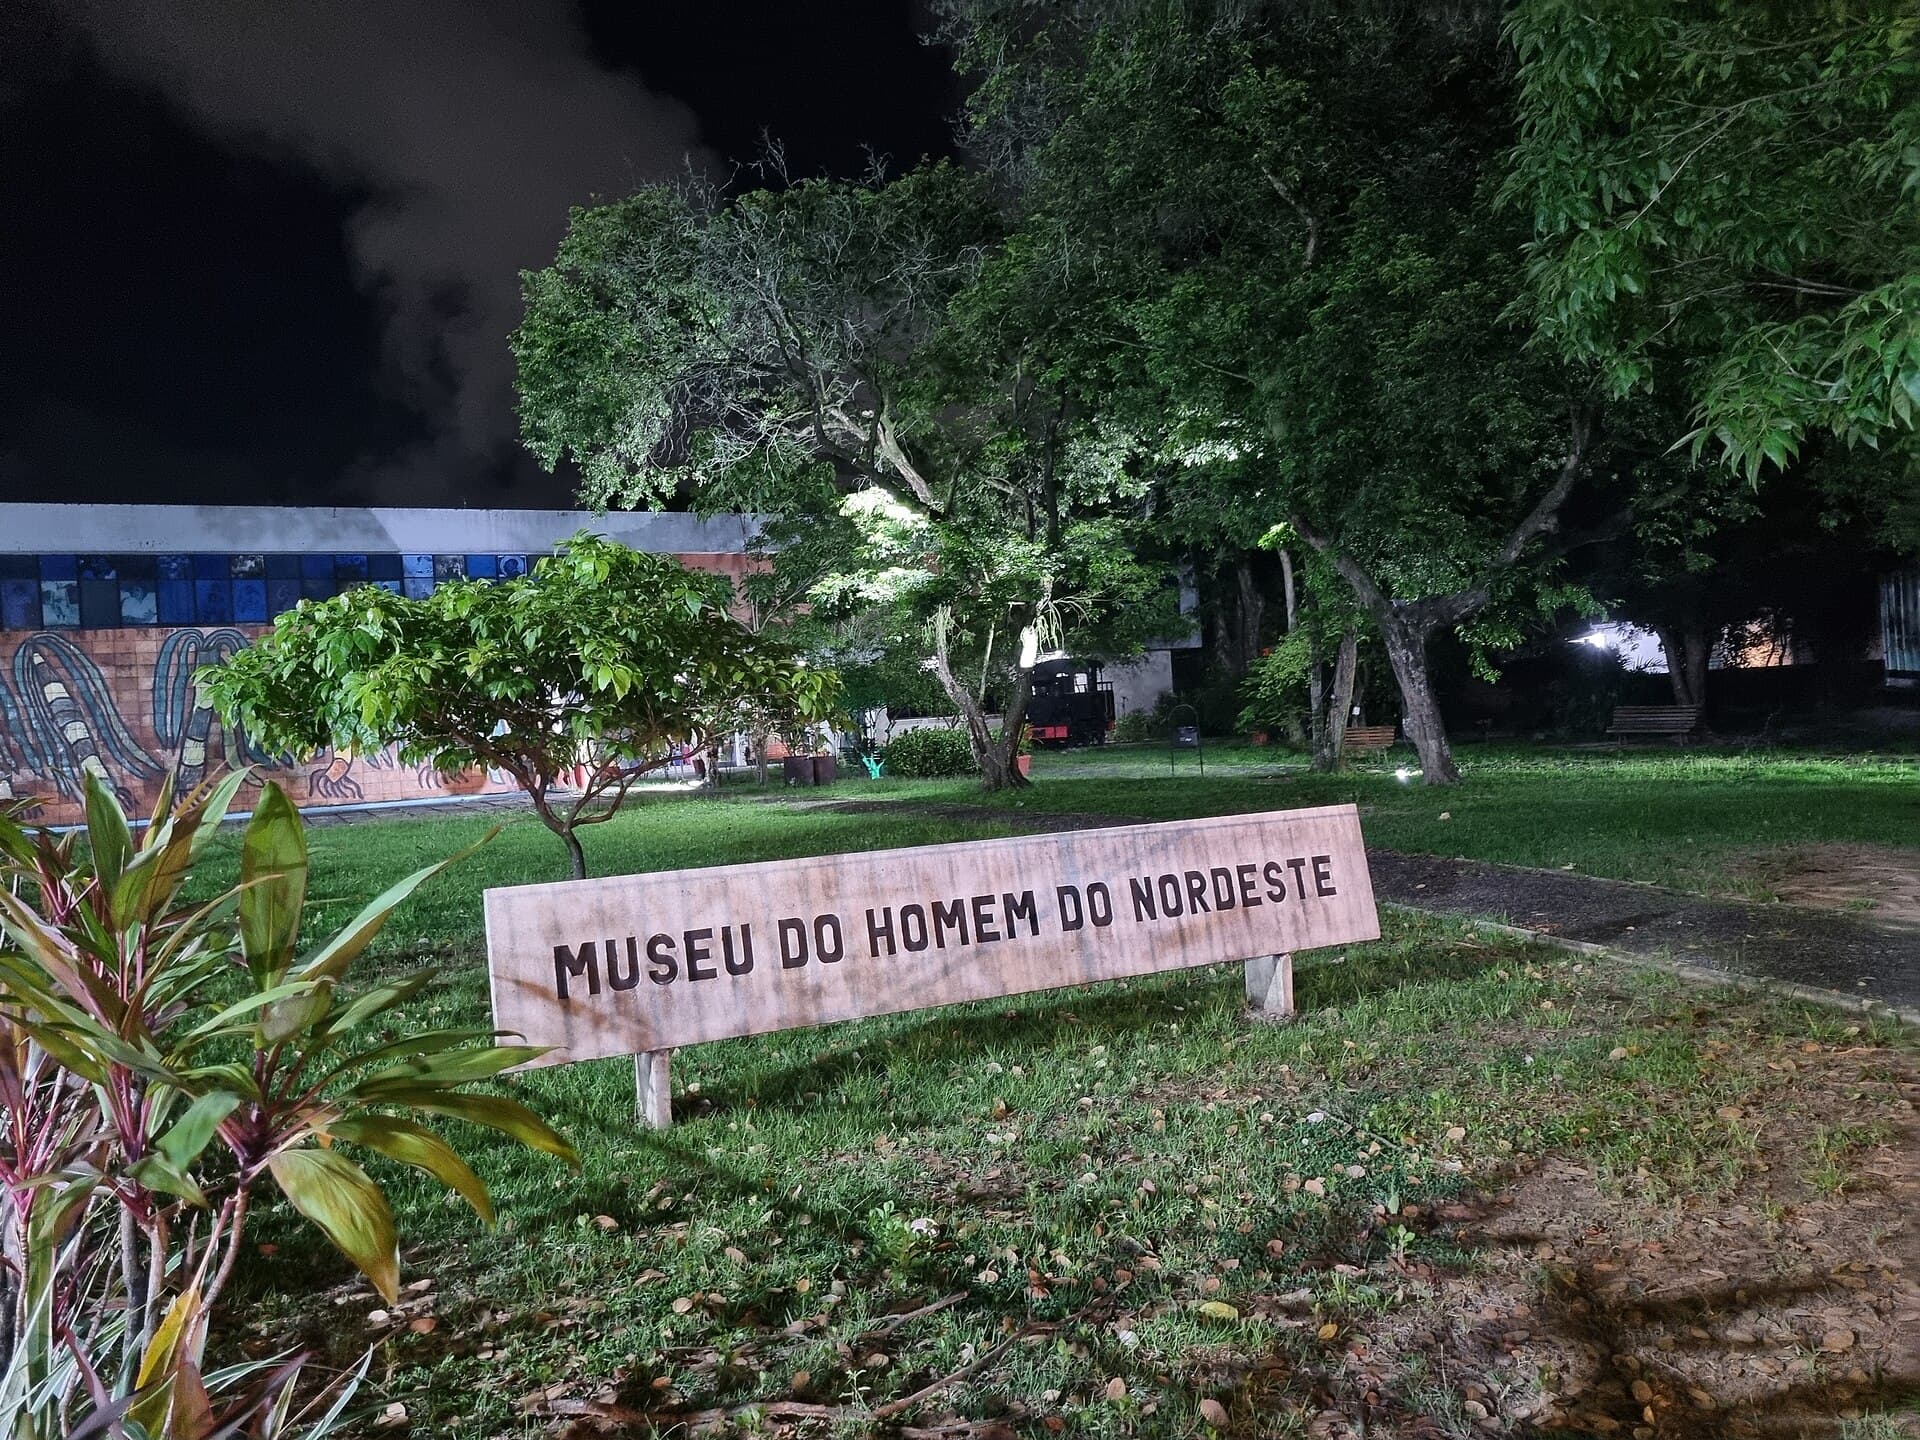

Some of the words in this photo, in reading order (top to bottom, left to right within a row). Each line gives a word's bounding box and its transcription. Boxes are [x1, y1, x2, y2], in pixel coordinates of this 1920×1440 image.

[554, 923, 754, 999] MUSEU
[778, 914, 844, 969] DO
[866, 890, 1040, 957] HOMEM
[1057, 882, 1115, 932] DO
[1130, 855, 1337, 922] NORDESTE
